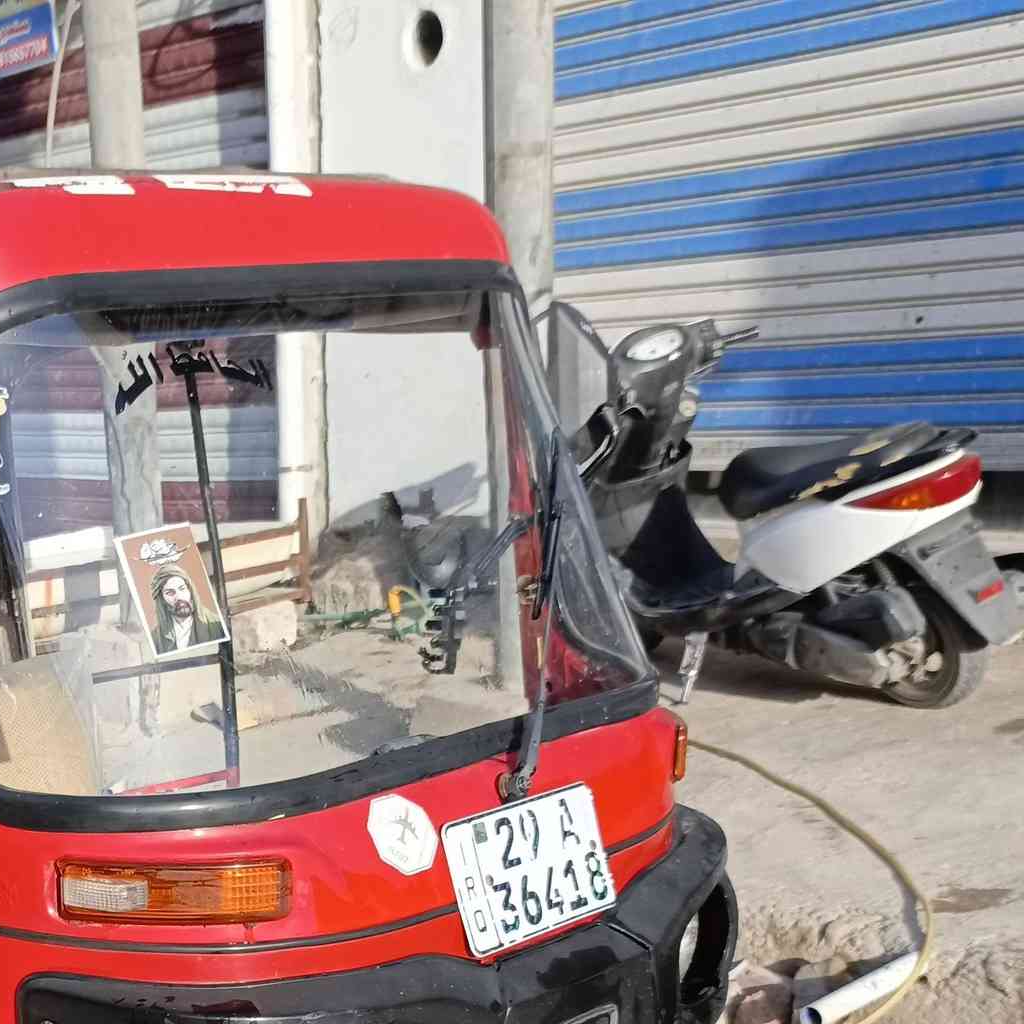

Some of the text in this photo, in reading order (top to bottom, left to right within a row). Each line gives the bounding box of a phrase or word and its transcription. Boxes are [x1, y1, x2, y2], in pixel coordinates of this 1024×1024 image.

[559, 798, 581, 849] A
[459, 841, 488, 933] IRQ
[492, 851, 609, 934] 36418
